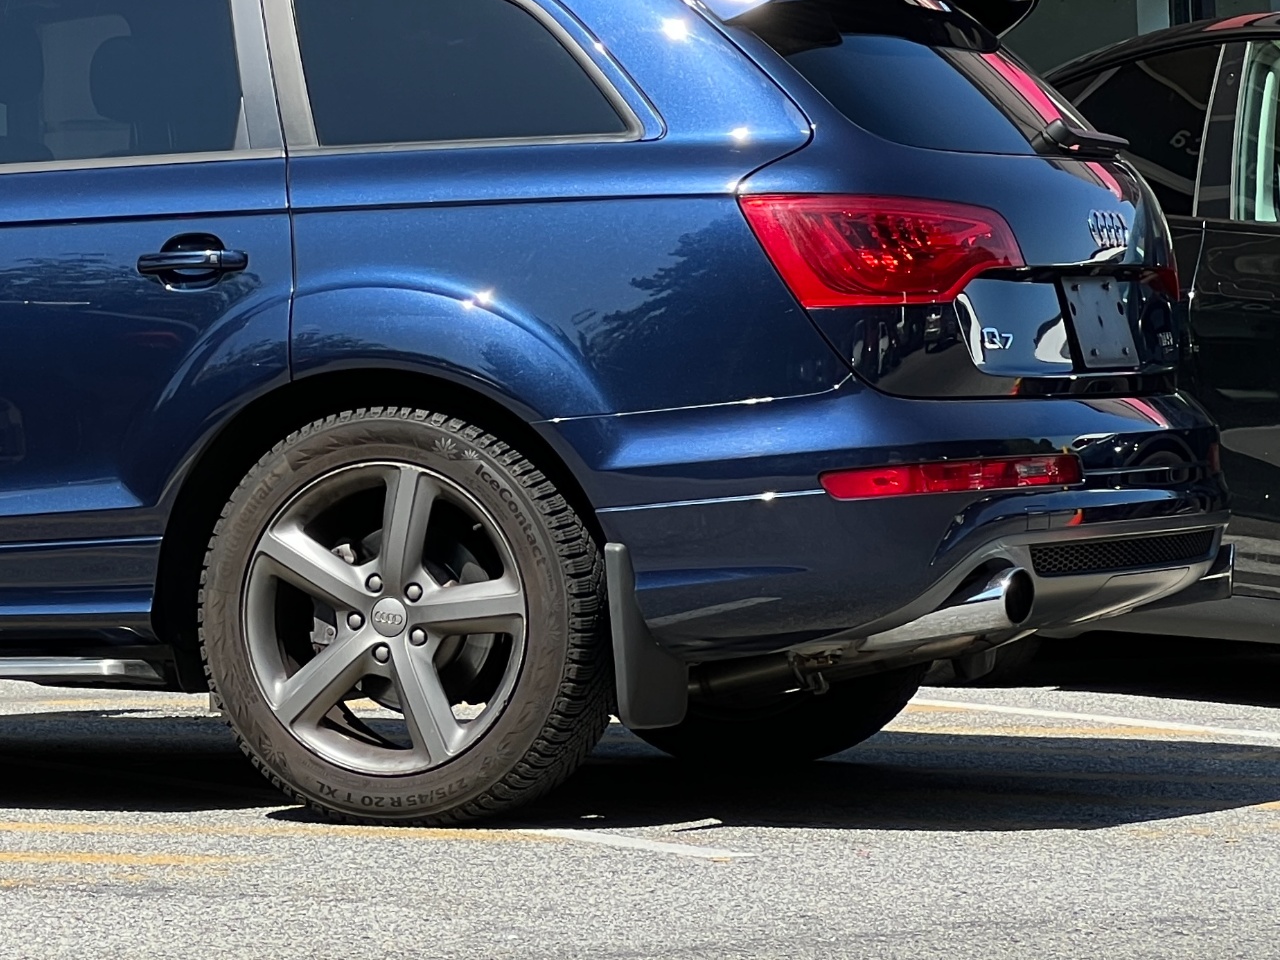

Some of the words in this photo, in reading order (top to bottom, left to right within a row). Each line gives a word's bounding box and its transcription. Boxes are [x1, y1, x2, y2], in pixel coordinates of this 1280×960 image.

[981, 326, 1014, 350] Q7
[474, 463, 547, 567] IceContact
[316, 780, 339, 800] XL
[343, 792, 355, 804] T
[407, 777, 469, 808] 275/45
[361, 795, 386, 808] 20
[390, 796, 402, 808] R
